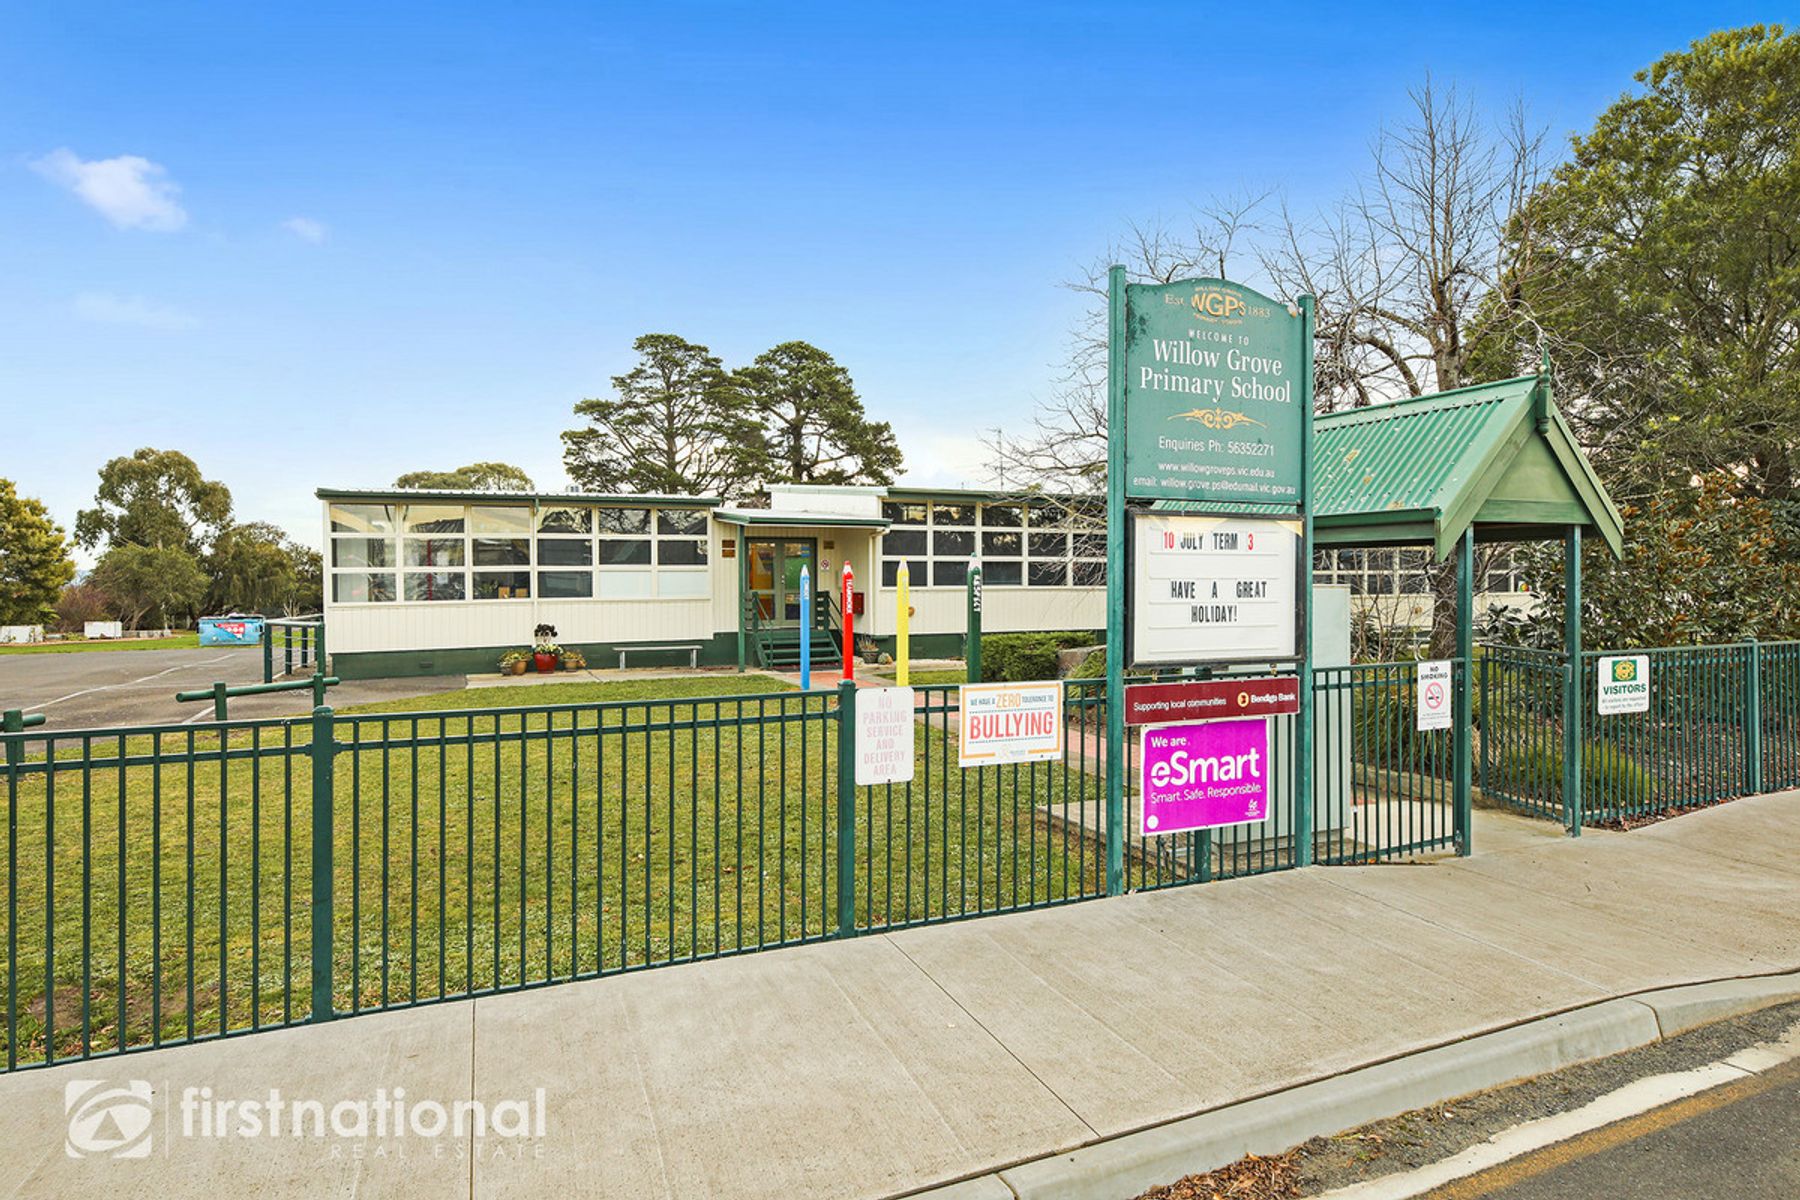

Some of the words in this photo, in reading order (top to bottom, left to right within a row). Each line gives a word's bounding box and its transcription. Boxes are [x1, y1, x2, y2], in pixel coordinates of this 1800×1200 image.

[1248, 306, 1271, 318] 1883
[1188, 329, 1234, 344] WELCOME
[1238, 336, 1250, 346] TO
[1153, 338, 1220, 368] Willow
[1227, 348, 1283, 376] Grove
[1140, 366, 1225, 403] Primary
[1231, 376, 1291, 403] School
[1159, 435, 1205, 452] Enquiries
[1227, 441, 1275, 456] 56352271
[1163, 532, 1175, 549] 10
[1180, 533, 1204, 550] JULY
[1213, 533, 1239, 550] TERM
[1248, 533, 1254, 550] 3
[1171, 581, 1196, 599] HAVE
[1211, 581, 1218, 599] A
[1236, 581, 1267, 598] GREAT
[1191, 605, 1238, 623] HOLIDAY!
[1420, 672, 1448, 680] SMOKING
[1603, 683, 1647, 695] VISITORS
[879, 696, 892, 708] NO
[996, 693, 1022, 708] ZERO
[1133, 702, 1169, 712] Supporting
[1170, 700, 1186, 709] local
[1187, 698, 1227, 708] communities
[1250, 694, 1277, 705] Bendigo
[1278, 693, 1296, 702] Bank
[863, 710, 907, 725] PARKING
[866, 725, 903, 738] SERVICE
[970, 711, 1054, 740] BULLYING
[876, 738, 895, 750] AND
[1151, 737, 1169, 748] We
[1170, 736, 1187, 746] are
[864, 751, 905, 764] DELIVERY
[873, 763, 897, 776] AREA
[1151, 748, 1261, 787] eSmart
